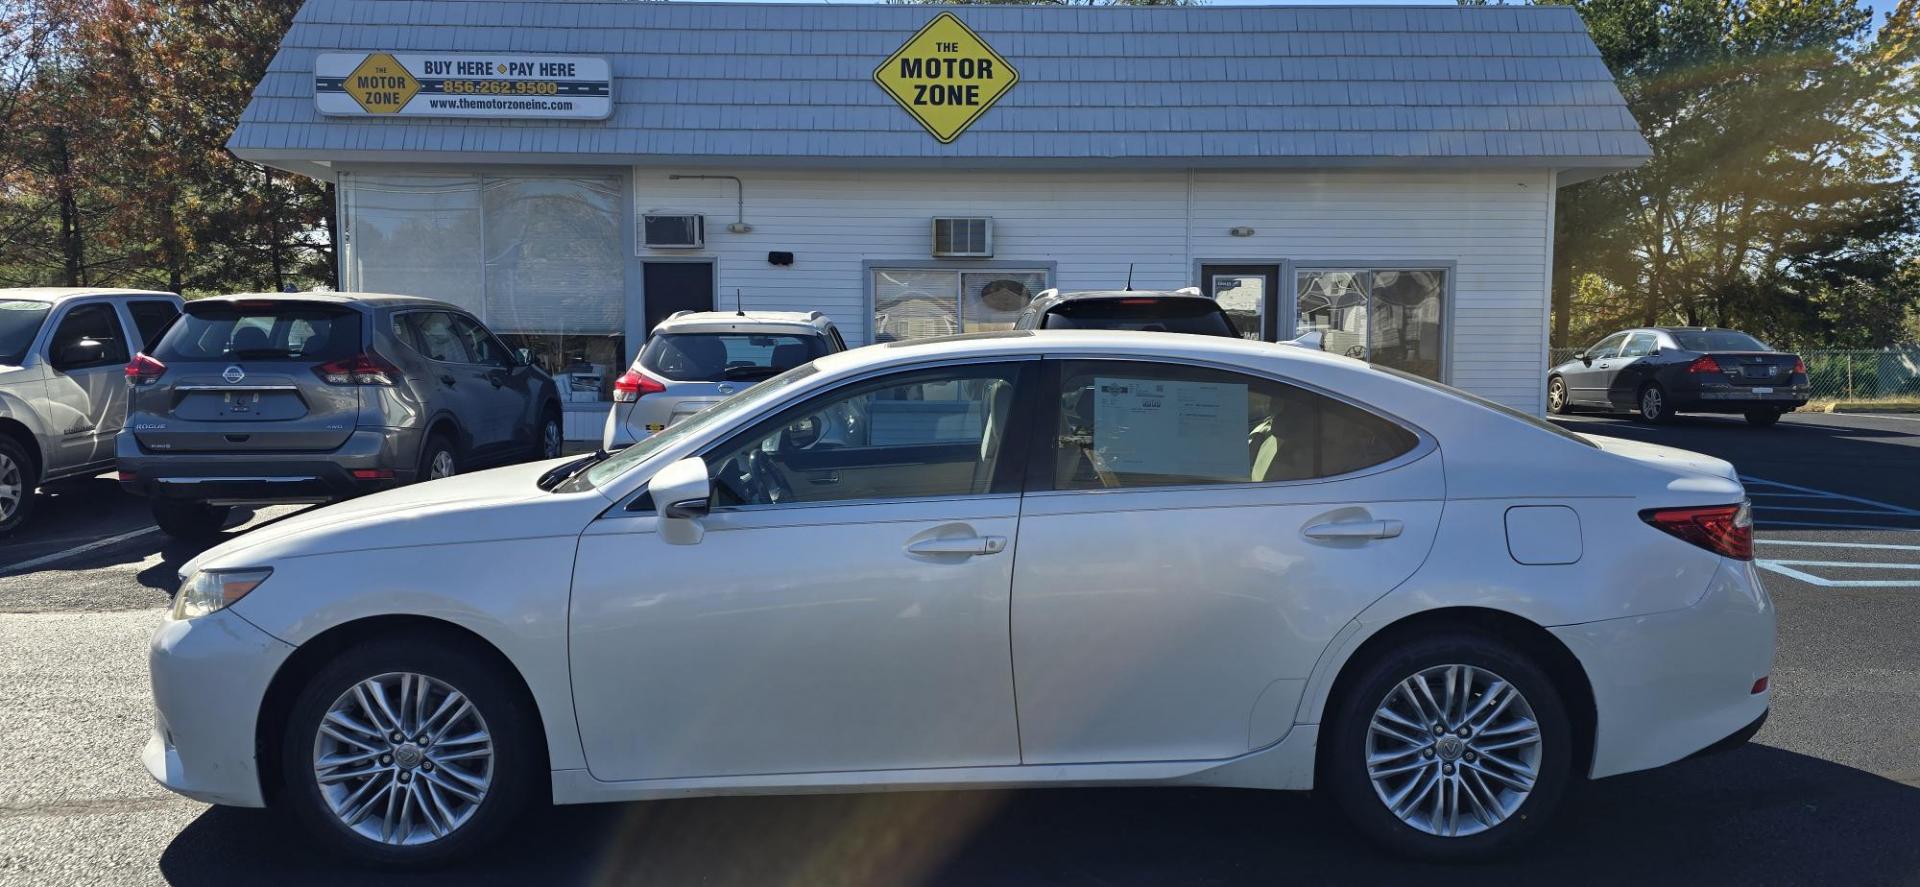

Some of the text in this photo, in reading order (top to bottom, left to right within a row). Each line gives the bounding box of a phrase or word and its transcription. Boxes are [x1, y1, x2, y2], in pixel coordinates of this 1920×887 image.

[936, 42, 958, 52] THE
[424, 61, 575, 77] BUY HERE PAY HERE
[900, 58, 993, 79] MOTOR
[357, 76, 406, 89] MOTOR
[443, 80, 558, 95] 856.262.9500
[365, 92, 400, 105] ZONE
[914, 84, 979, 106] ZONE
[430, 98, 573, 111] www.themotorzoneinc.com
